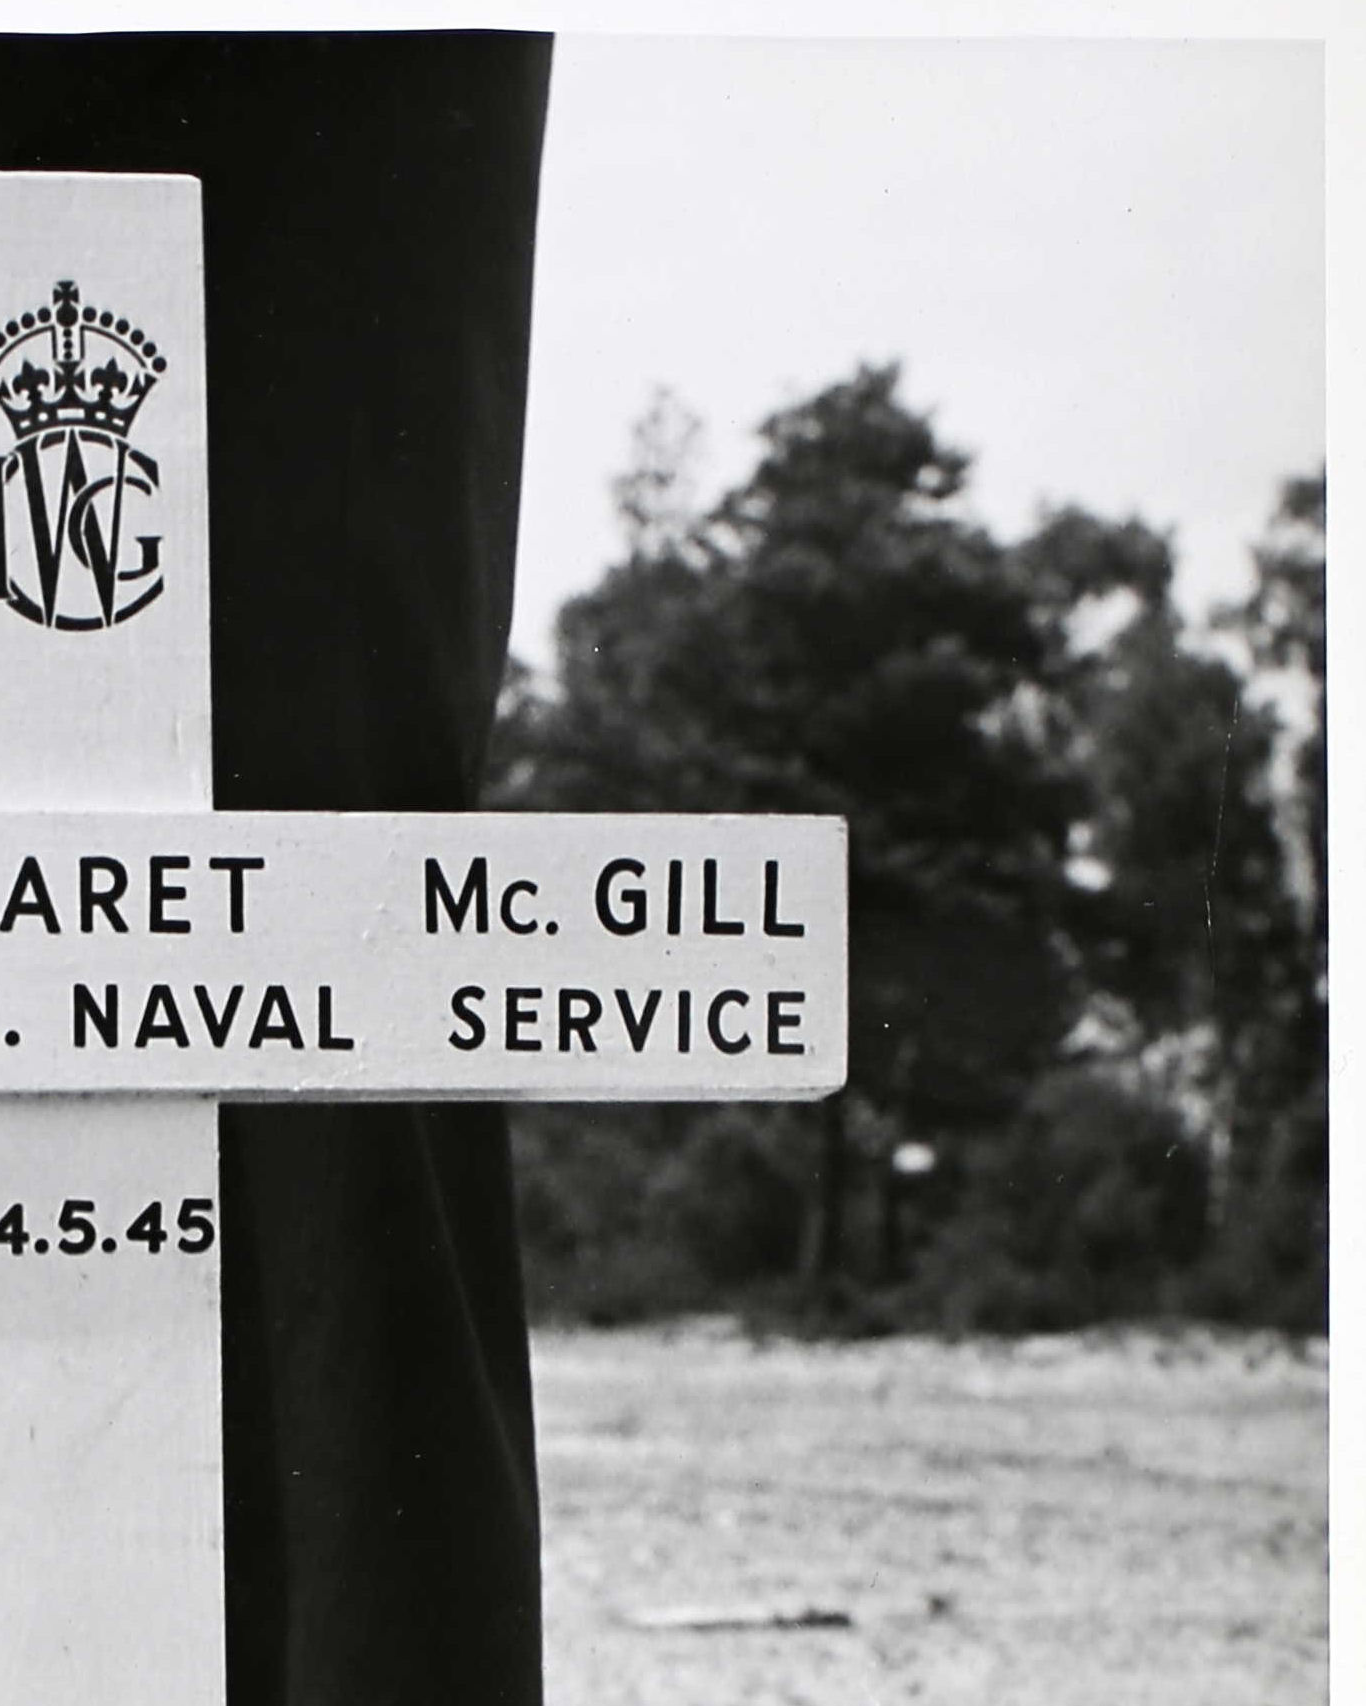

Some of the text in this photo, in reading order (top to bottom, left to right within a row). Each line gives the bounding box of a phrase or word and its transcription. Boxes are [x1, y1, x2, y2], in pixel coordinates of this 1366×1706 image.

[423, 856, 560, 937] Mc.
[594, 857, 806, 938] GILL
[72, 982, 356, 1051] NAVAL
[447, 984, 807, 1056] SERVICE
